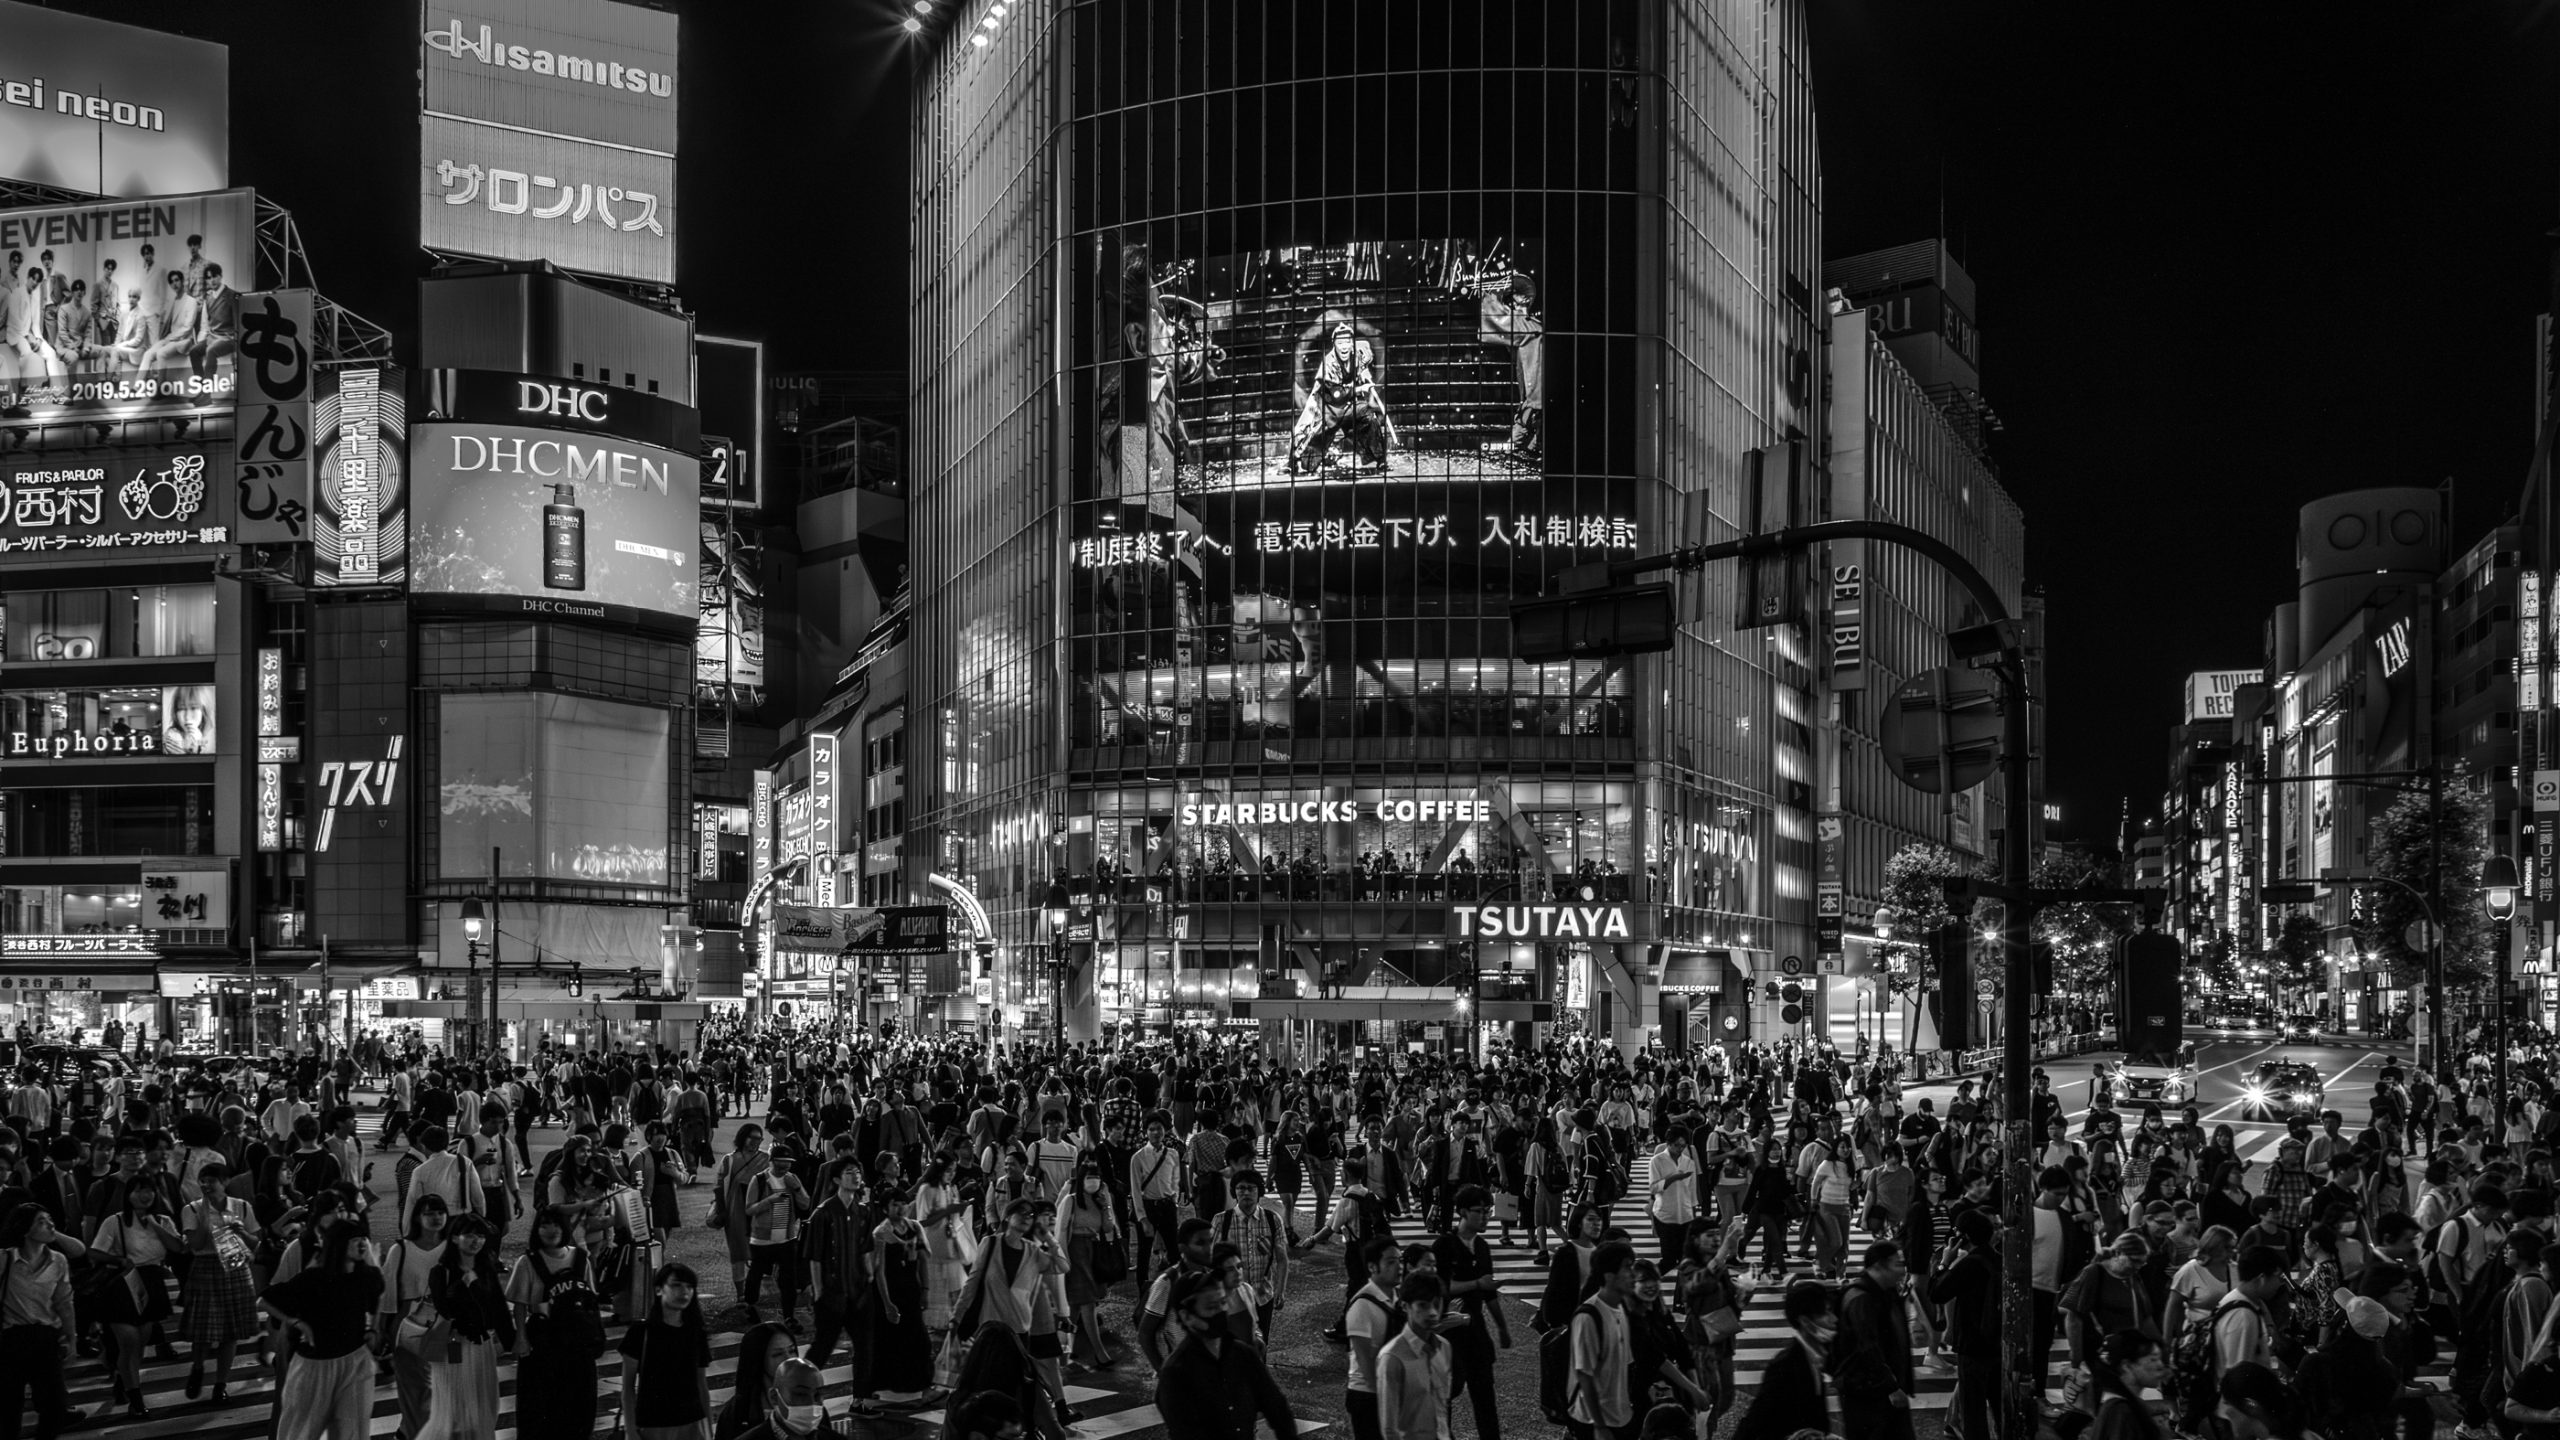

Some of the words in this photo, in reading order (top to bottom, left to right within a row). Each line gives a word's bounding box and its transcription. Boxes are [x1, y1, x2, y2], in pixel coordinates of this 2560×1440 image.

[424, 19, 672, 97] Hisamitsu
[57, 89, 164, 132] neon
[437, 160, 662, 236] サロンパス
[0, 205, 176, 249] EVENTEEN
[72, 379, 158, 400] 2019.5.29
[161, 380, 184, 396] on
[187, 373, 236, 394] Sale!
[517, 380, 608, 421] DHC
[240, 297, 308, 536] もんじゃ
[16, 469, 104, 483] FRUITS&PARLOR
[340, 378, 370, 571] 三千里薬品
[450, 435, 669, 496] DHCMEN
[712, 448, 747, 486] 21
[15, 485, 103, 526] 西村
[1070, 529, 1232, 569] 制度終了へ。
[1254, 515, 1456, 553] 電気料金下げ、
[1480, 514, 1637, 550] 入札制検討
[522, 600, 553, 614] DHC
[554, 602, 605, 617] Channel
[1834, 564, 1861, 679] SEIBU
[12, 728, 155, 758] Euphoria
[814, 747, 831, 831] カラオケ
[2226, 762, 2239, 828] KARAOKE
[1182, 800, 1357, 826] STARBUCKS
[1377, 800, 1490, 822] COFFEE
[1453, 906, 1629, 937] TSUTAYA
[1821, 895, 1838, 912] 本
[2350, 887, 2363, 920] ARA
[7, 939, 51, 950] 渋谷西村
[366, 981, 410, 997] 里薬品
[1690, 985, 1720, 993] COFFEE
